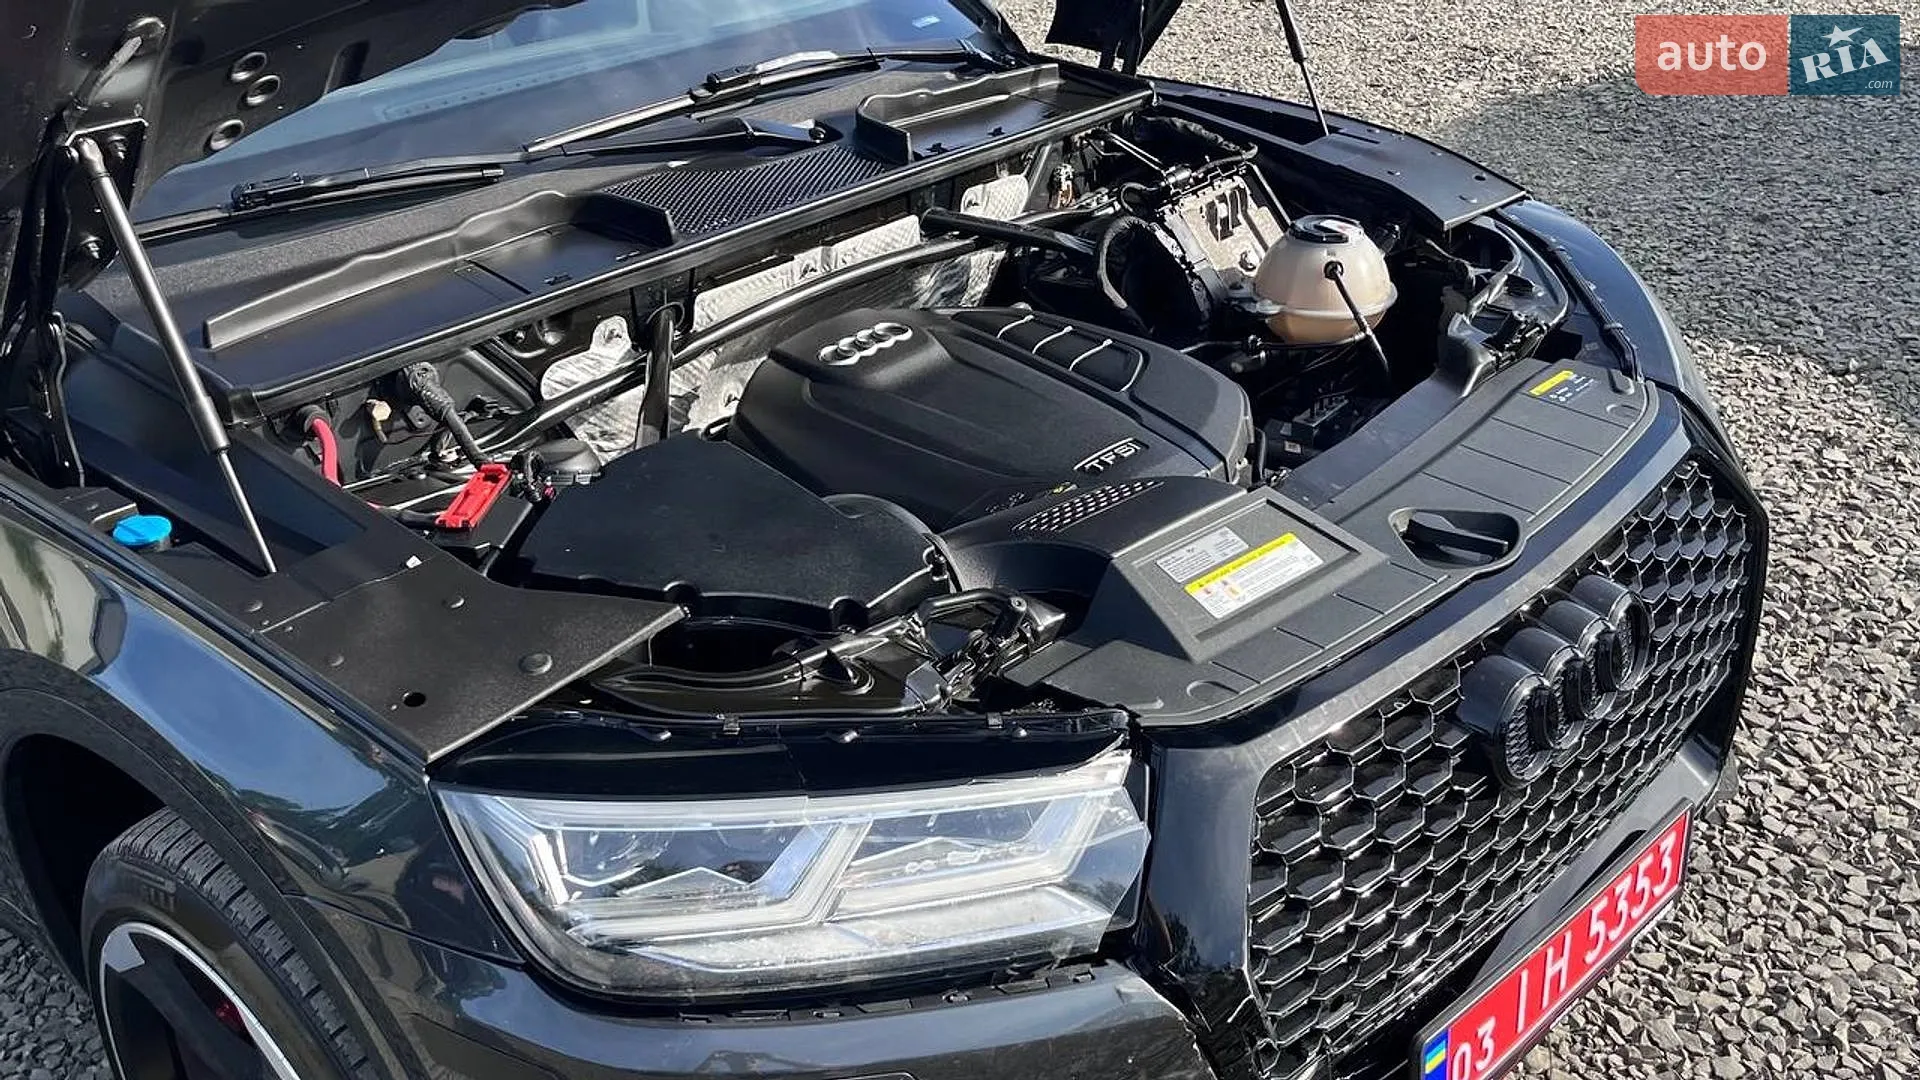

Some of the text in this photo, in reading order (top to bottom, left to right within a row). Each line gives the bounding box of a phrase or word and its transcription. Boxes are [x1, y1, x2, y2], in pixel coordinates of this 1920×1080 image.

[1084, 442, 1141, 471] TFSI
[1453, 830, 1678, 1080] 03 IH 5353
